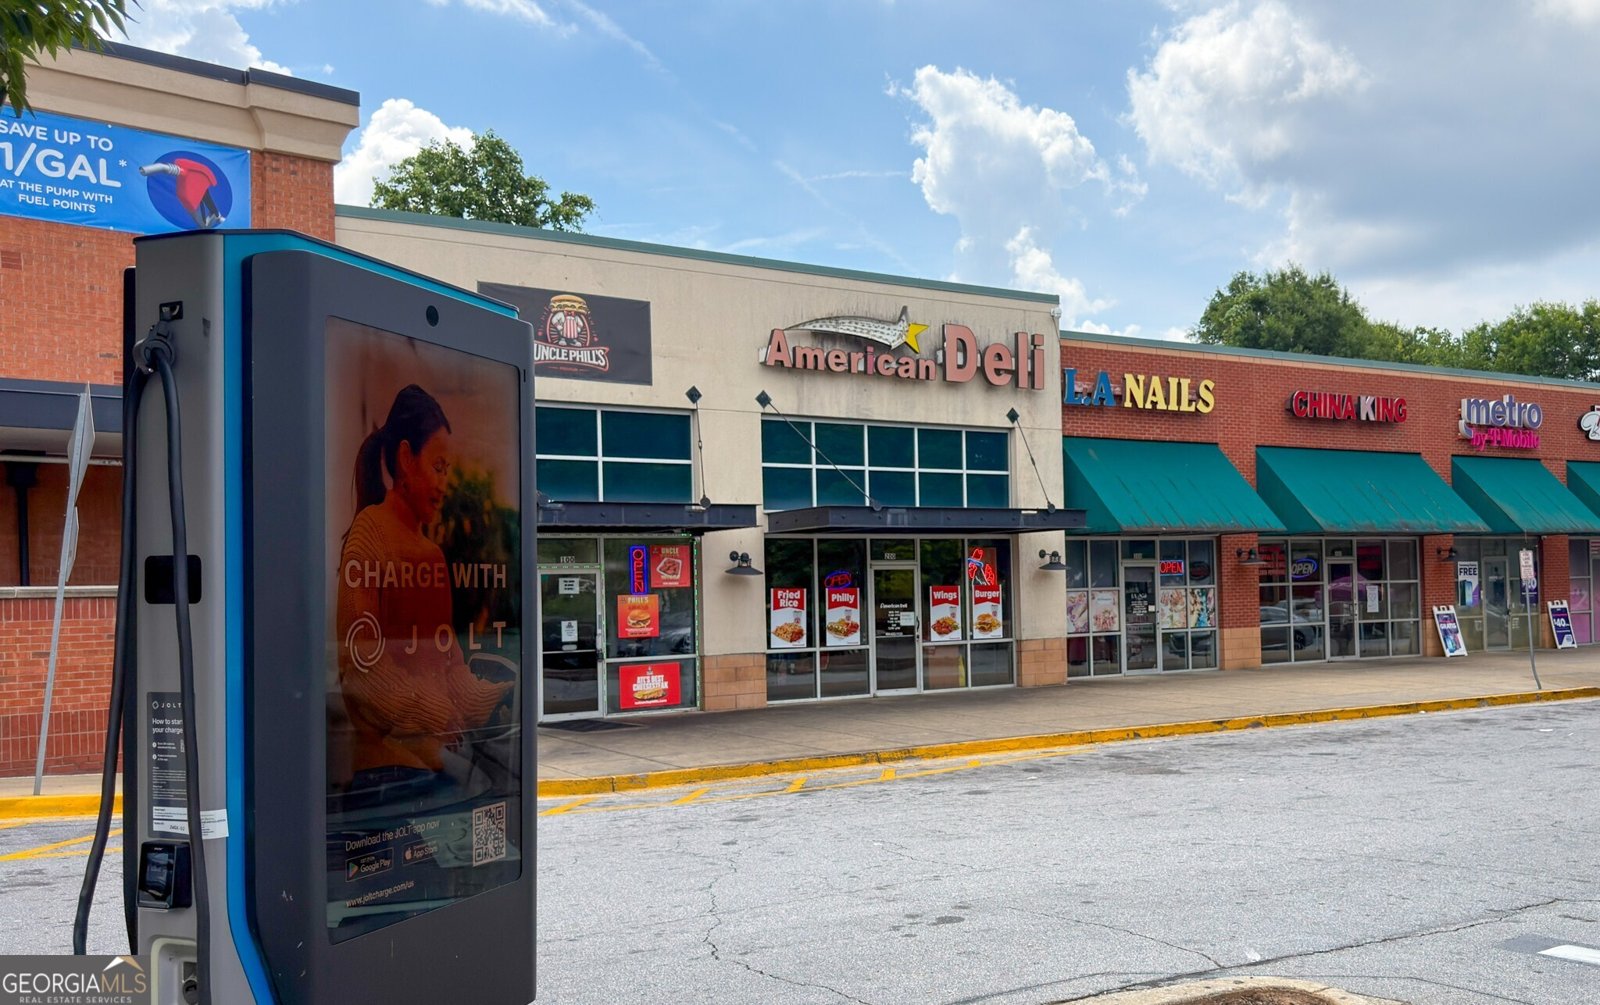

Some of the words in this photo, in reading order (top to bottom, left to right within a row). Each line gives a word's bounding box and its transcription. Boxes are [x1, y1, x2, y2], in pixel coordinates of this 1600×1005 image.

[0, 120, 48, 141] SAVE
[54, 130, 81, 146] UP
[87, 135, 113, 151] TO
[0, 180, 14, 189] AT
[18, 181, 42, 193] THE
[46, 185, 79, 199] PUMP
[82, 191, 113, 204] WITH
[18, 194, 49, 207] FUEL
[53, 199, 96, 213] POINTS
[533, 343, 568, 361] UNCLE
[569, 349, 606, 366] PHILL'S
[764, 328, 937, 381] American
[942, 323, 1045, 390] Deli
[1123, 373, 1215, 414] NAILS
[1292, 390, 1357, 420] CHINA
[1358, 395, 1407, 423] KING
[1460, 394, 1543, 430] metro
[1471, 428, 1488, 451] by
[344, 559, 446, 589] CHARGE
[452, 562, 507, 589] WITH
[632, 548, 645, 593] OPEN
[1160, 561, 1183, 574] OPEN
[1291, 562, 1315, 575] OPEN
[1459, 567, 1478, 576] FREE
[777, 590, 800, 599] Fried
[780, 599, 799, 607] Rice
[831, 593, 855, 603] Philly
[933, 591, 957, 600] Wings
[975, 590, 1000, 599] Burger
[404, 621, 507, 654] JOLT
[152, 727, 164, 735] your
[165, 727, 183, 735] charge
[345, 831, 381, 852] Download
[382, 831, 394, 842] the
[395, 825, 412, 840] JOLT
[412, 823, 426, 835] app
[426, 820, 440, 830] now
[413, 849, 424, 859] App
[424, 845, 438, 855] Store
[360, 860, 379, 873] Google
[379, 859, 391, 869] Play
